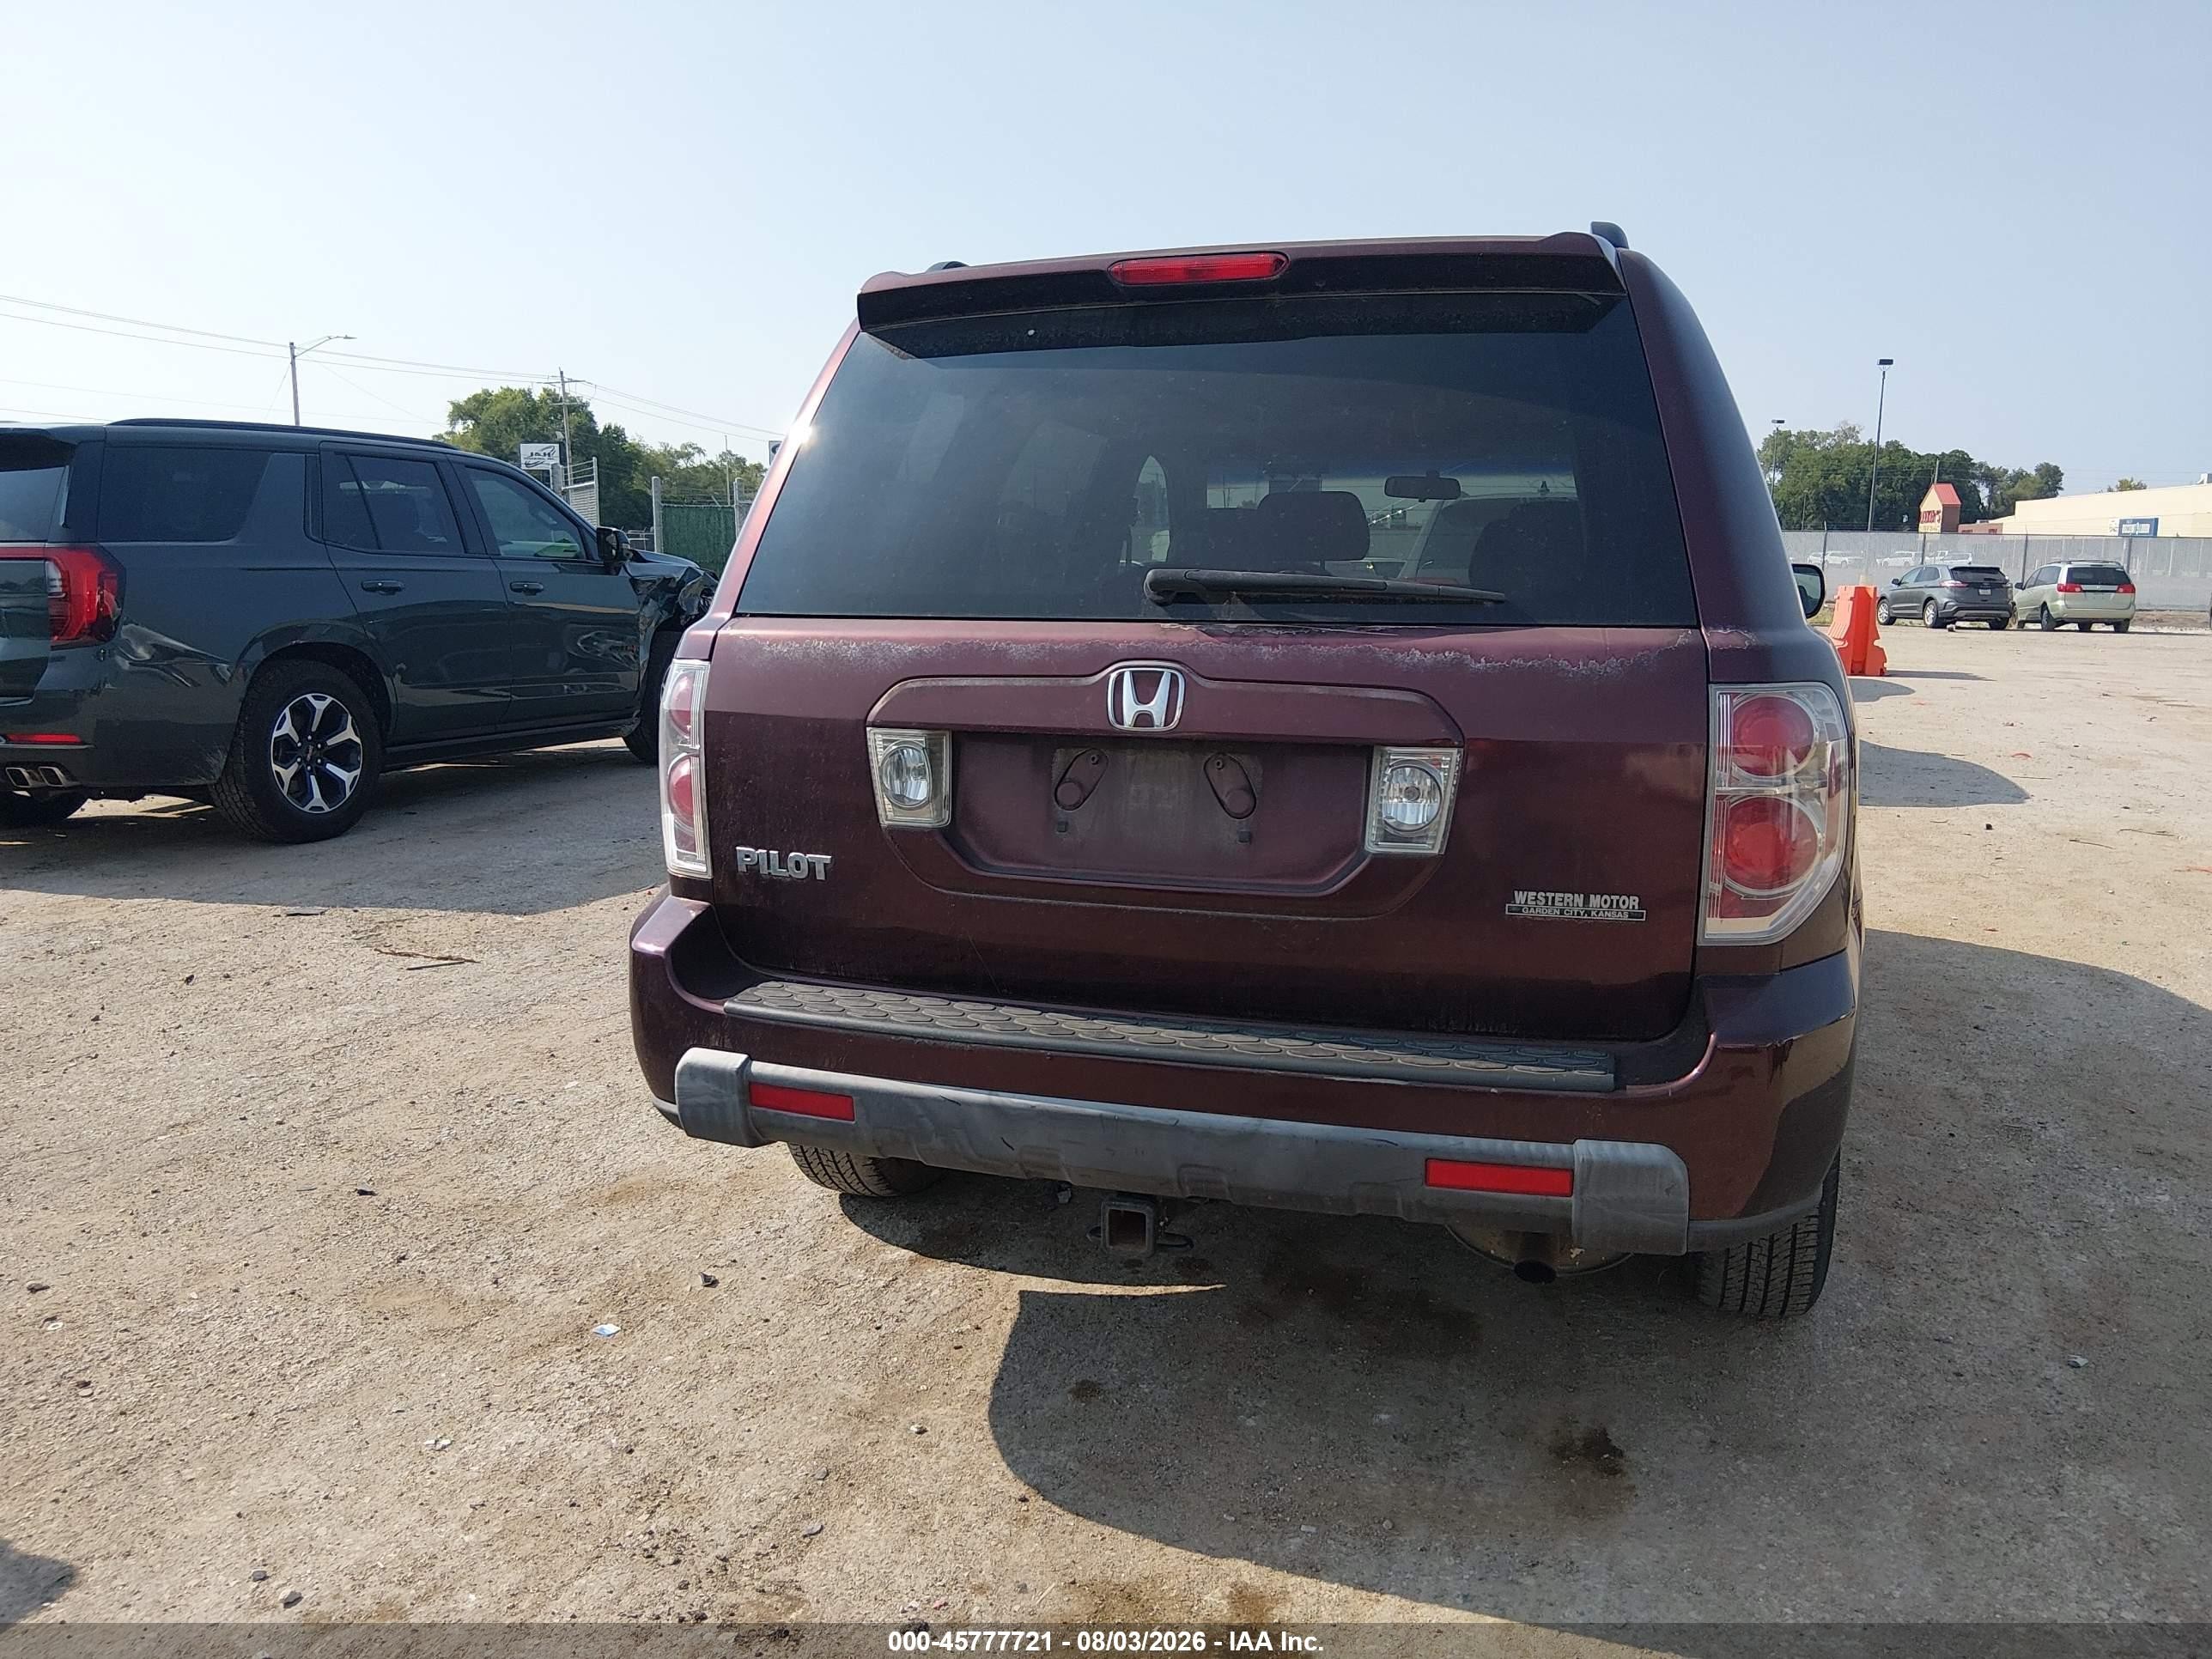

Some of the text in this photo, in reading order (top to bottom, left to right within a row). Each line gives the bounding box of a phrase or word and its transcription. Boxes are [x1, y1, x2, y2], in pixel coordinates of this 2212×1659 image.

[736, 846, 832, 881] PILOT
[1514, 890, 1639, 909] WESTERN MOTOR
[1522, 907, 1629, 919] GARDEN CITY, KANSAS
